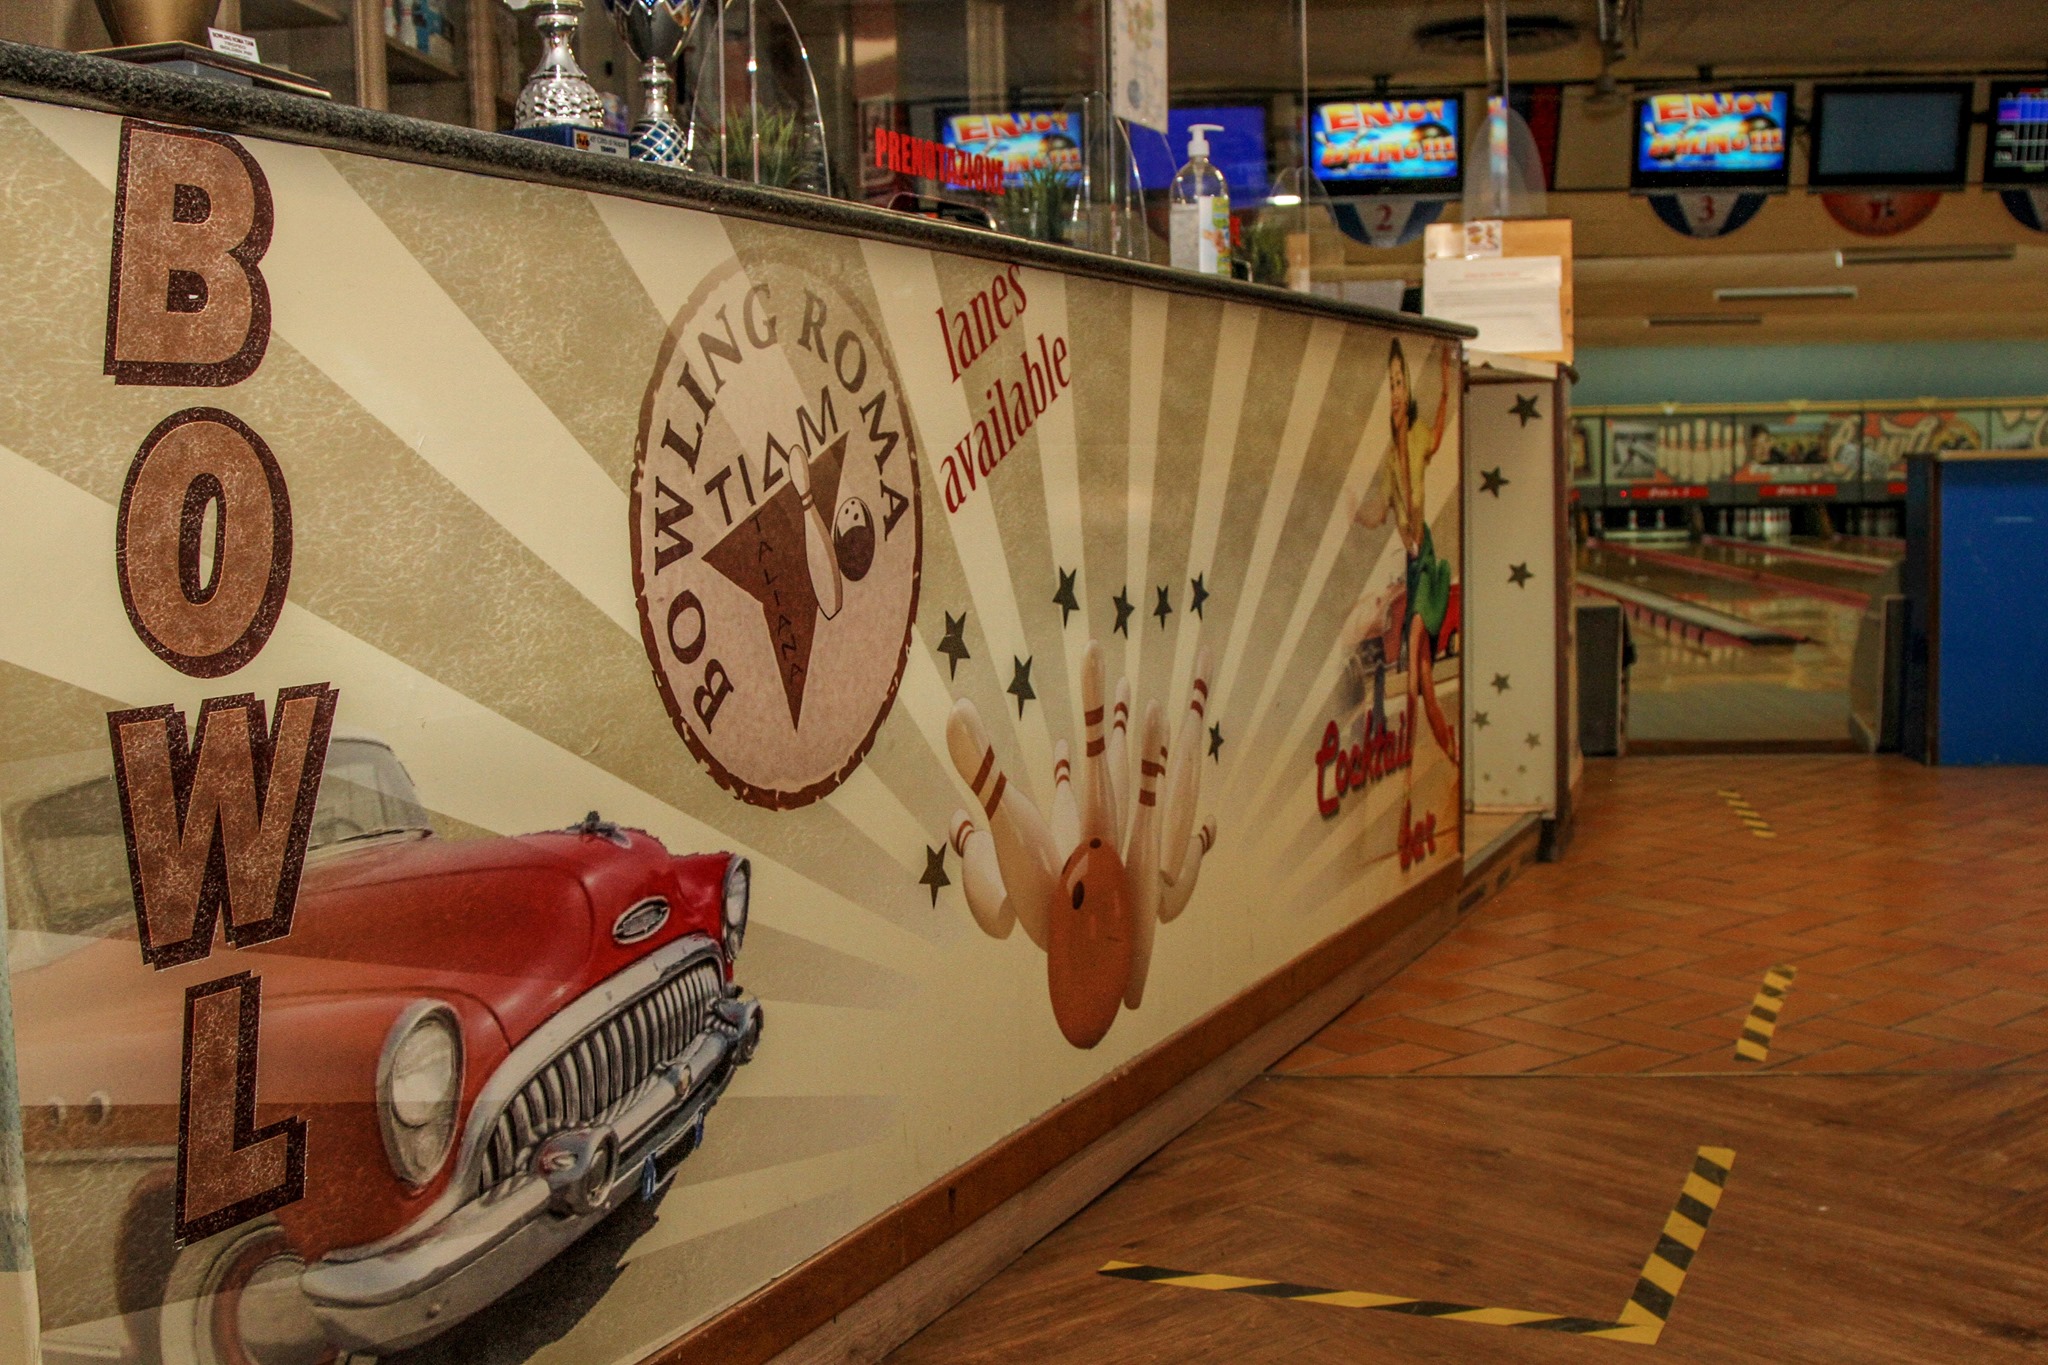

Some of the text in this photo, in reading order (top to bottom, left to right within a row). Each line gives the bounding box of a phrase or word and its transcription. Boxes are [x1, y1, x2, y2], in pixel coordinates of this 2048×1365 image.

[952, 113, 1068, 144] ENJOY
[1321, 101, 1444, 134] ENJOY
[1651, 92, 1774, 123] ENJOY
[875, 127, 1005, 195] PRENOTAZIONE
[1376, 204, 1393, 231] 2
[1699, 195, 1715, 222] 3
[936, 264, 1027, 383] lanes
[940, 333, 1072, 513] available
[654, 284, 910, 734] BOWLING ROMA
[104, 117, 340, 1250] BOWL
[1315, 693, 1413, 818] Cocktail
